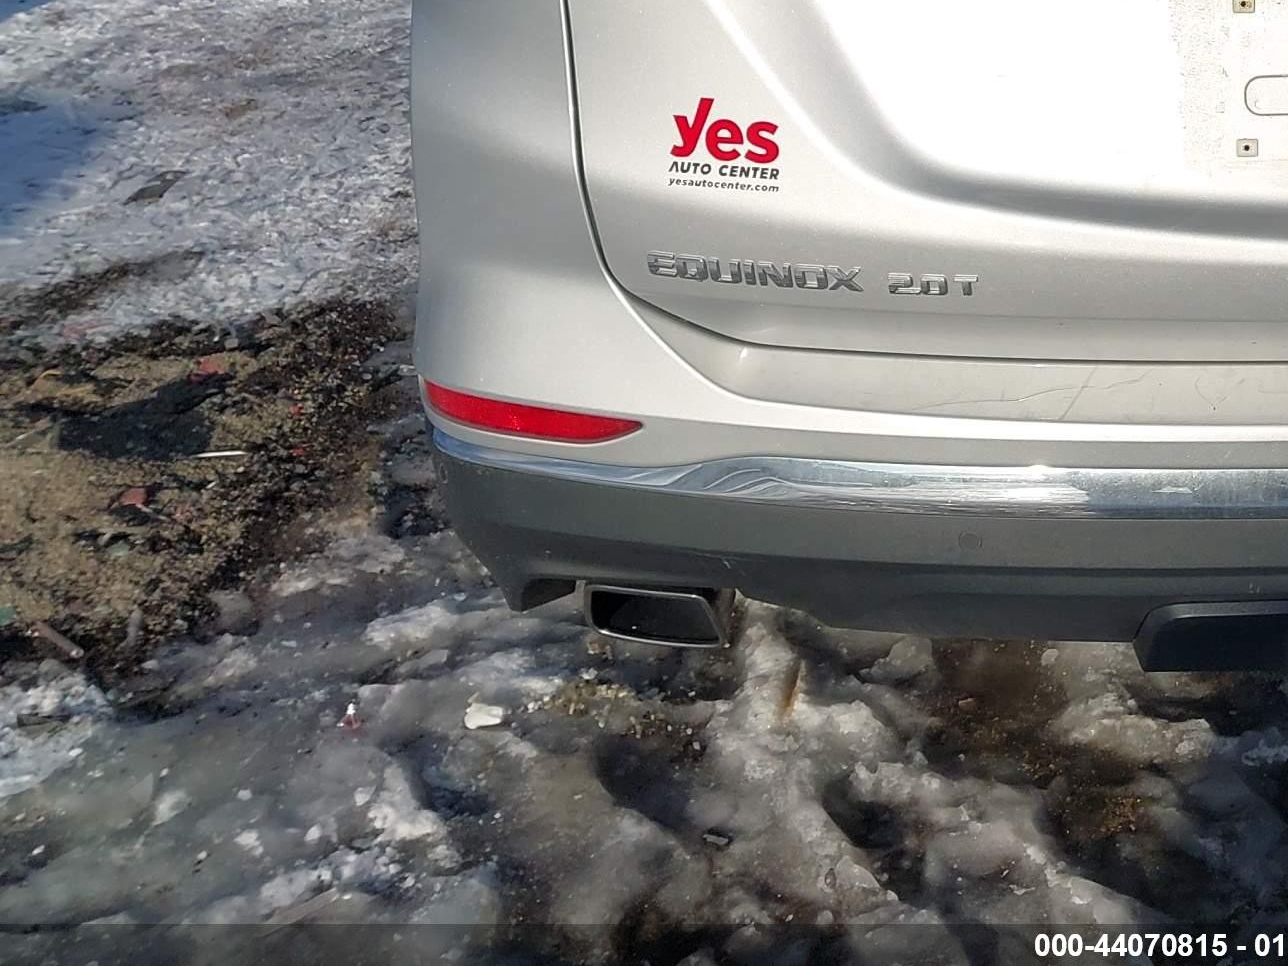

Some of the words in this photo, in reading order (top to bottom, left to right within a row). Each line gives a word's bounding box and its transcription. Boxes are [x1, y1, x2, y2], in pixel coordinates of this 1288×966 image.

[670, 97, 779, 164] yes
[668, 161, 712, 175] AUTO
[718, 164, 780, 180] CENTER
[668, 177, 780, 192] yesautocenter.com
[647, 250, 864, 292] EQUINOX
[887, 272, 979, 296] 2.0T
